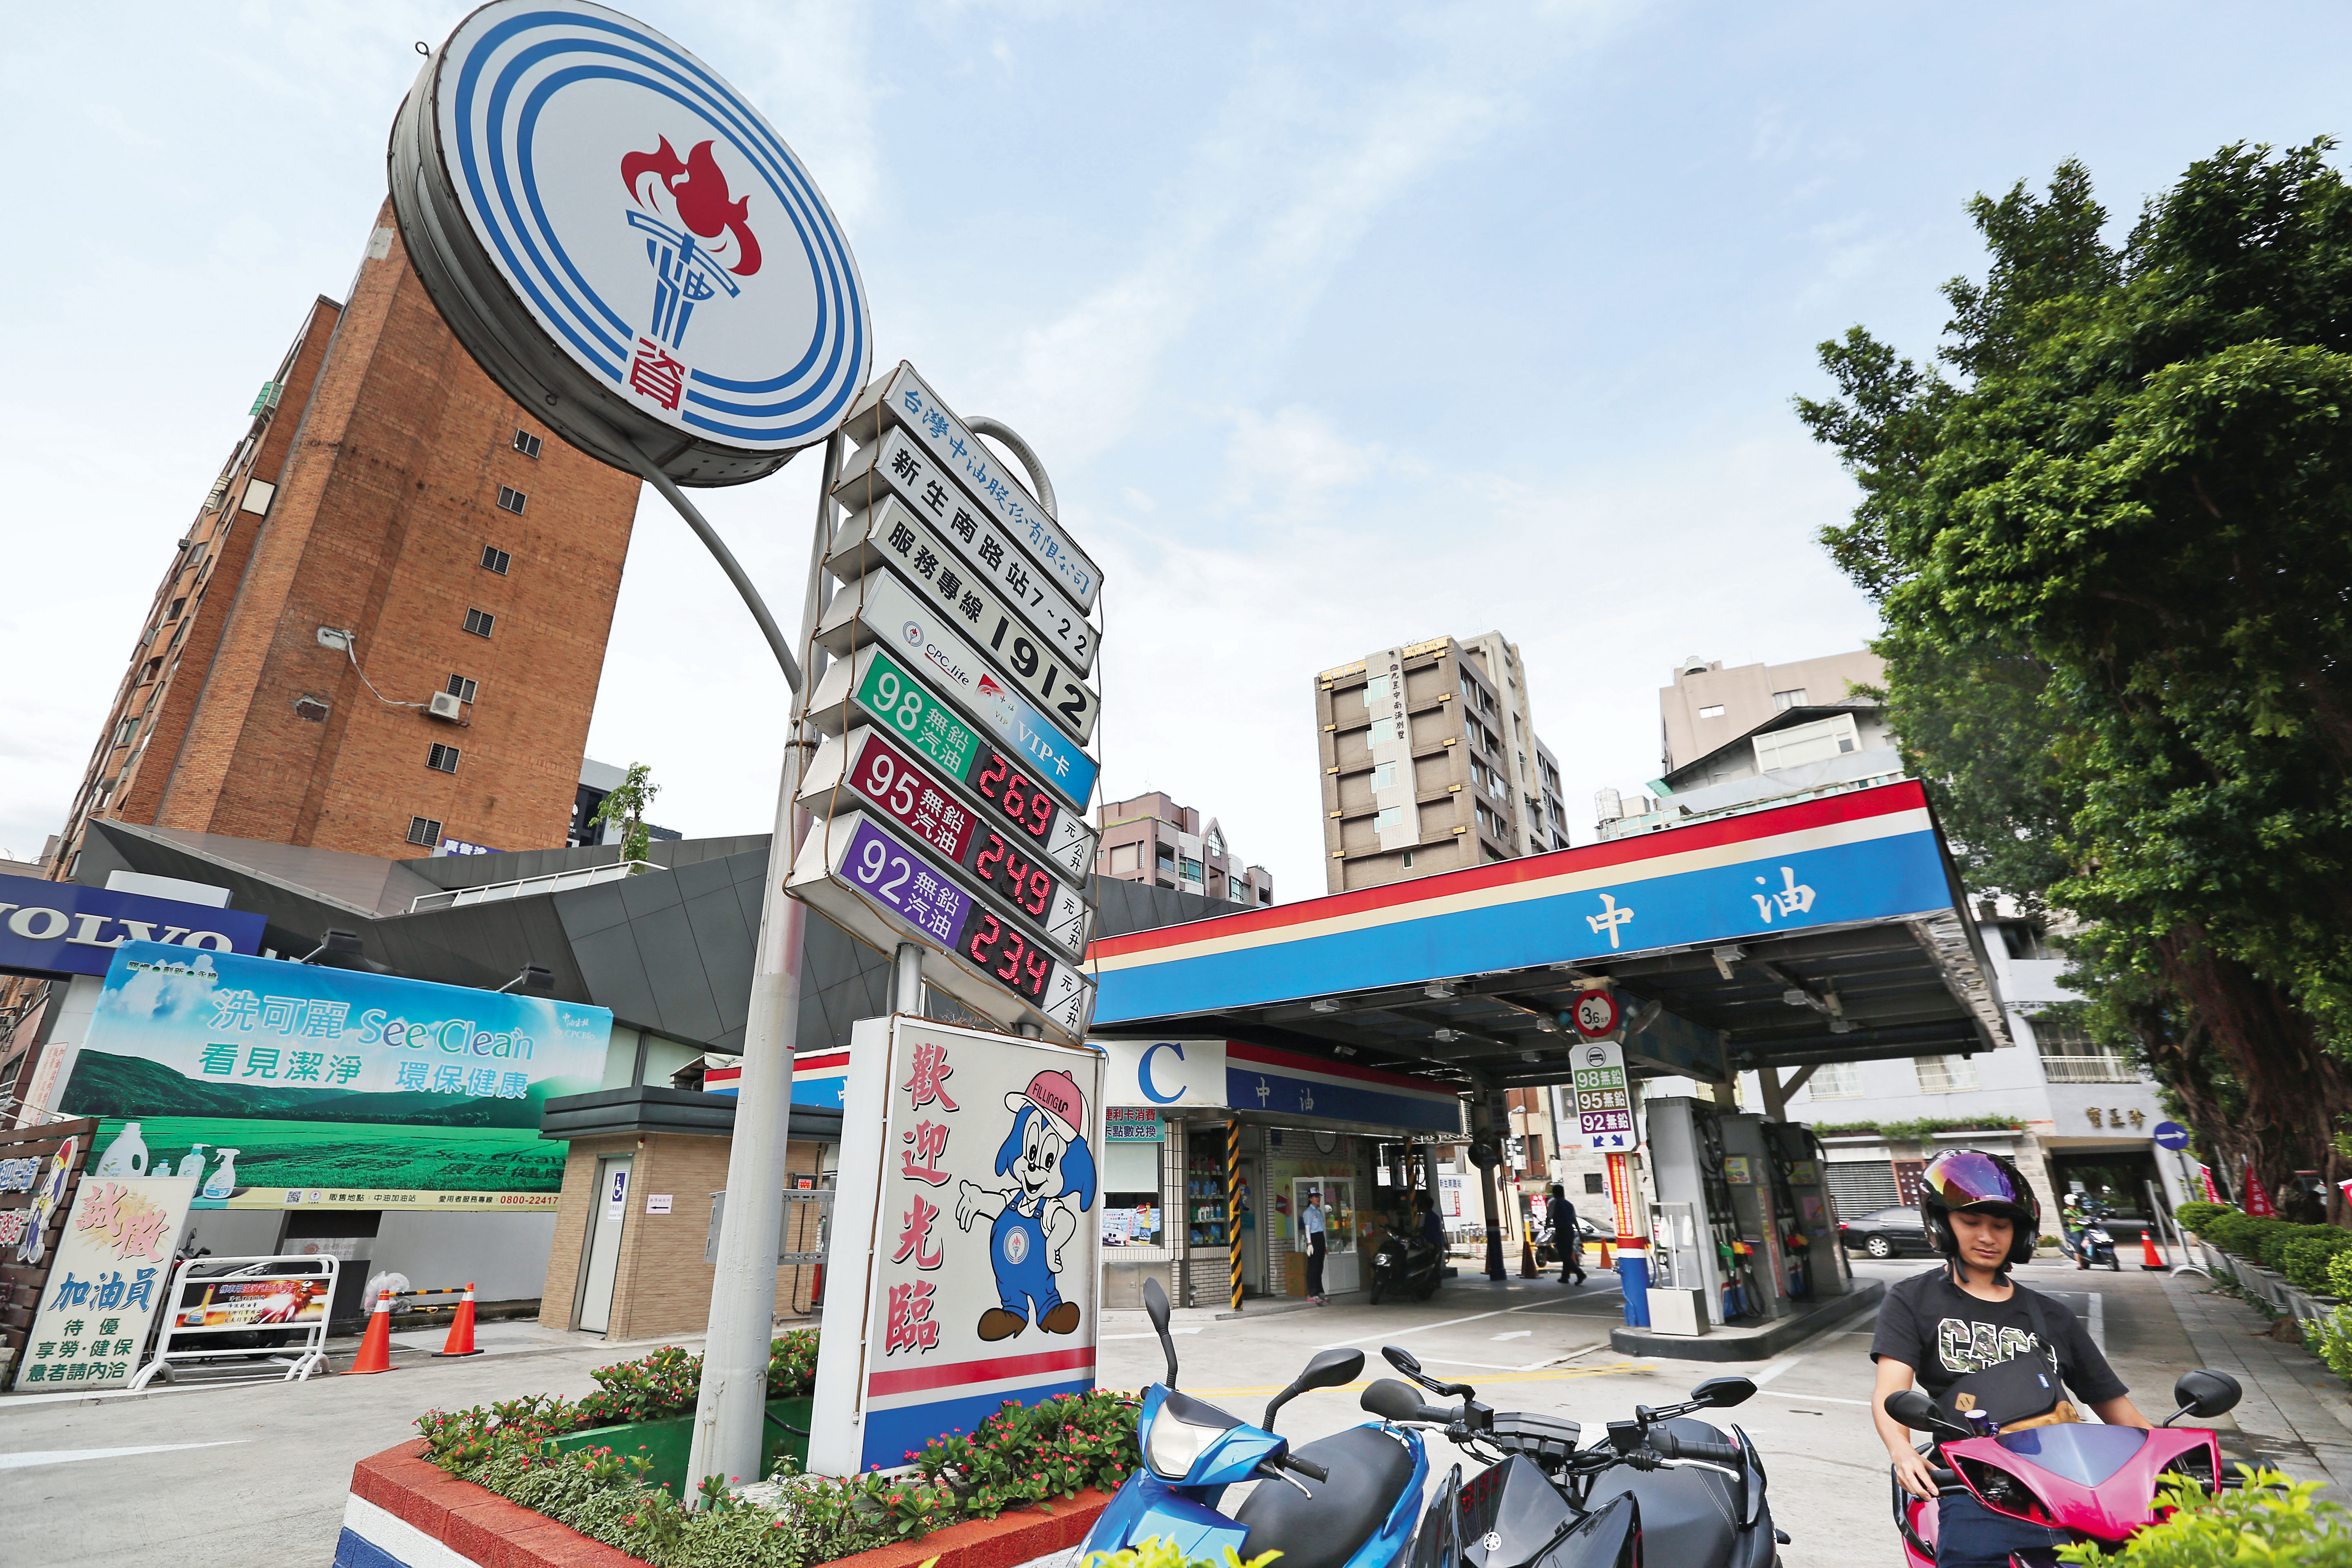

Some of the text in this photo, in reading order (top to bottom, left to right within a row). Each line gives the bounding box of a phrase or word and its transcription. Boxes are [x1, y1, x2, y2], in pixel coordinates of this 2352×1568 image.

[905, 390, 1089, 595] 台灣中油股份有限公司
[888, 521, 1087, 728] 服務專線 1912
[873, 673, 923, 731] 98
[926, 708, 969, 754] 無鉛
[996, 710, 1008, 725] VIP
[917, 725, 962, 774] 汽油
[866, 755, 920, 816] 95
[920, 789, 965, 835] 無鉛
[980, 755, 1051, 835] 26.9
[911, 808, 958, 856] 汽油
[857, 840, 911, 905] 92
[913, 871, 960, 917] 無鉛
[977, 834, 1050, 915] 24.9
[904, 892, 952, 940] 汽油
[1586, 866, 1816, 949] 中油
[971, 914, 1047, 994] 23.4
[207, 988, 534, 1061] 洗可麗 See Clean
[1581, 1007, 1600, 1025] 3.6
[199, 1042, 528, 1100] 看見潔淨 環保健康
[1256, 1076, 1314, 1112] 中油
[76, 1182, 169, 1263] 誠徵
[885, 1042, 960, 1357] 歡迎光臨
[47, 1267, 159, 1312] 加油員
[26, 1361, 128, 1383] 意者請內洽
